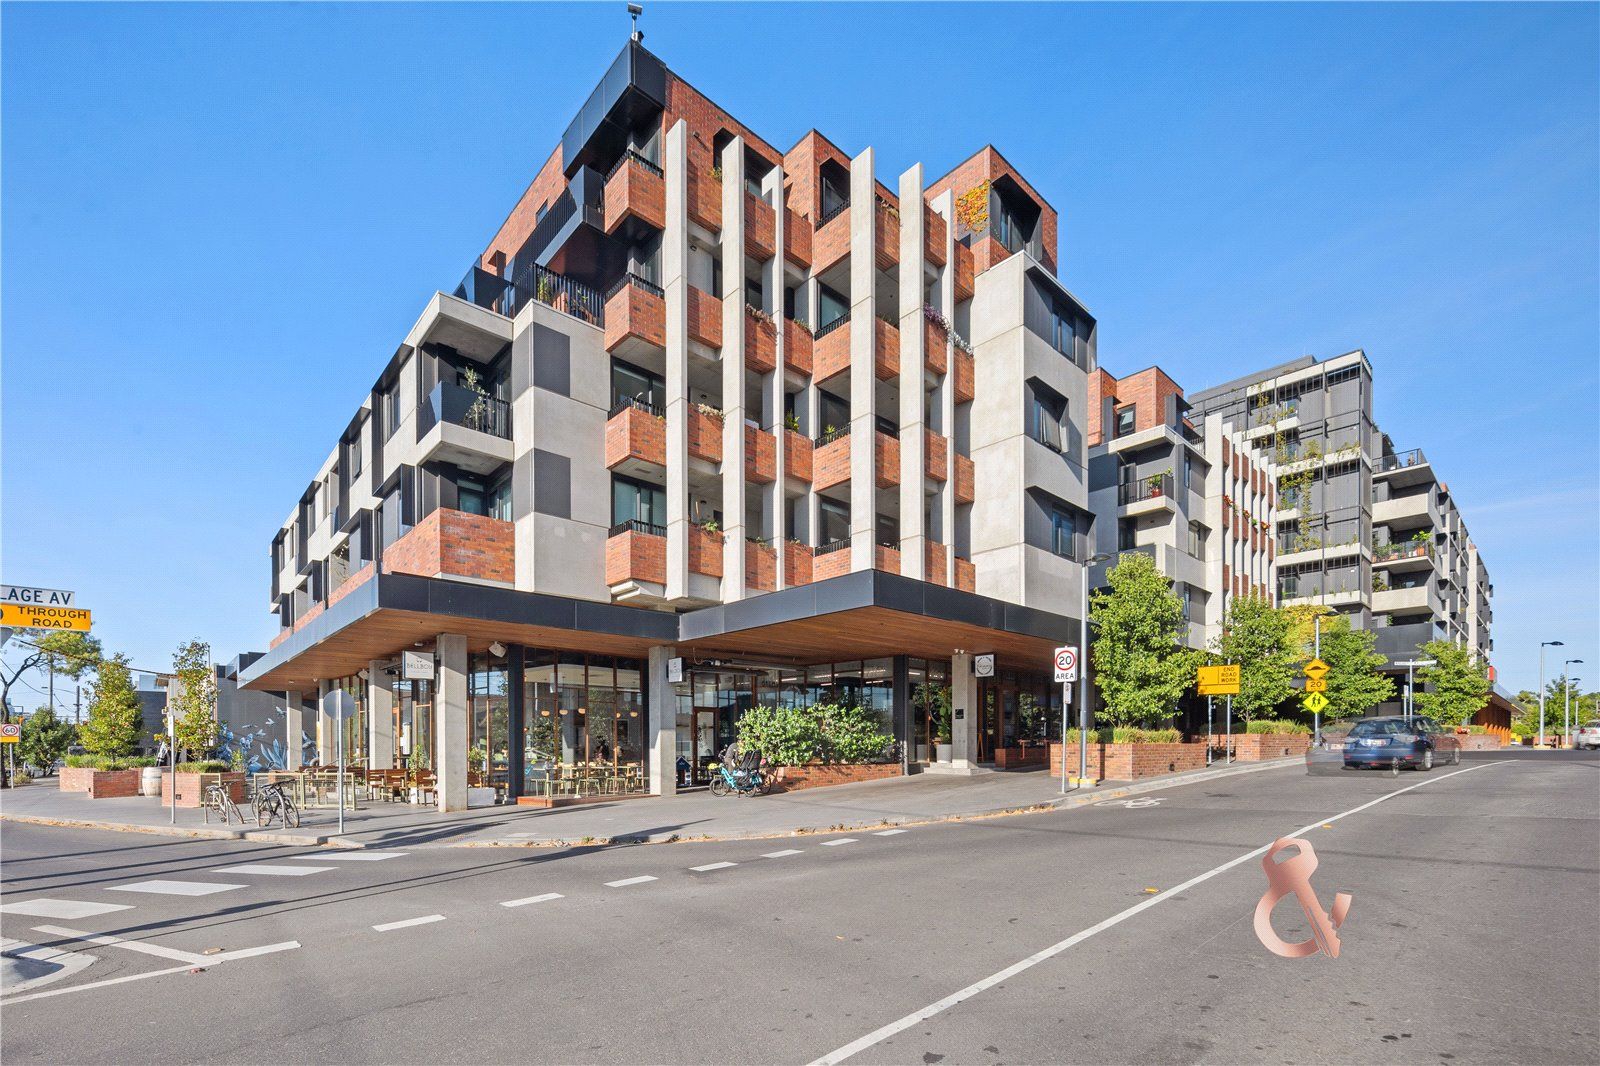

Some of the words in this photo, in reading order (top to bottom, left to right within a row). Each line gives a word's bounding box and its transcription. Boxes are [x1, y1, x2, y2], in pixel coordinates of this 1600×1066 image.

[49, 592, 71, 605] AV
[17, 606, 87, 619] THROUGH
[32, 618, 72, 628] ROAD
[1058, 656, 1072, 665] 20
